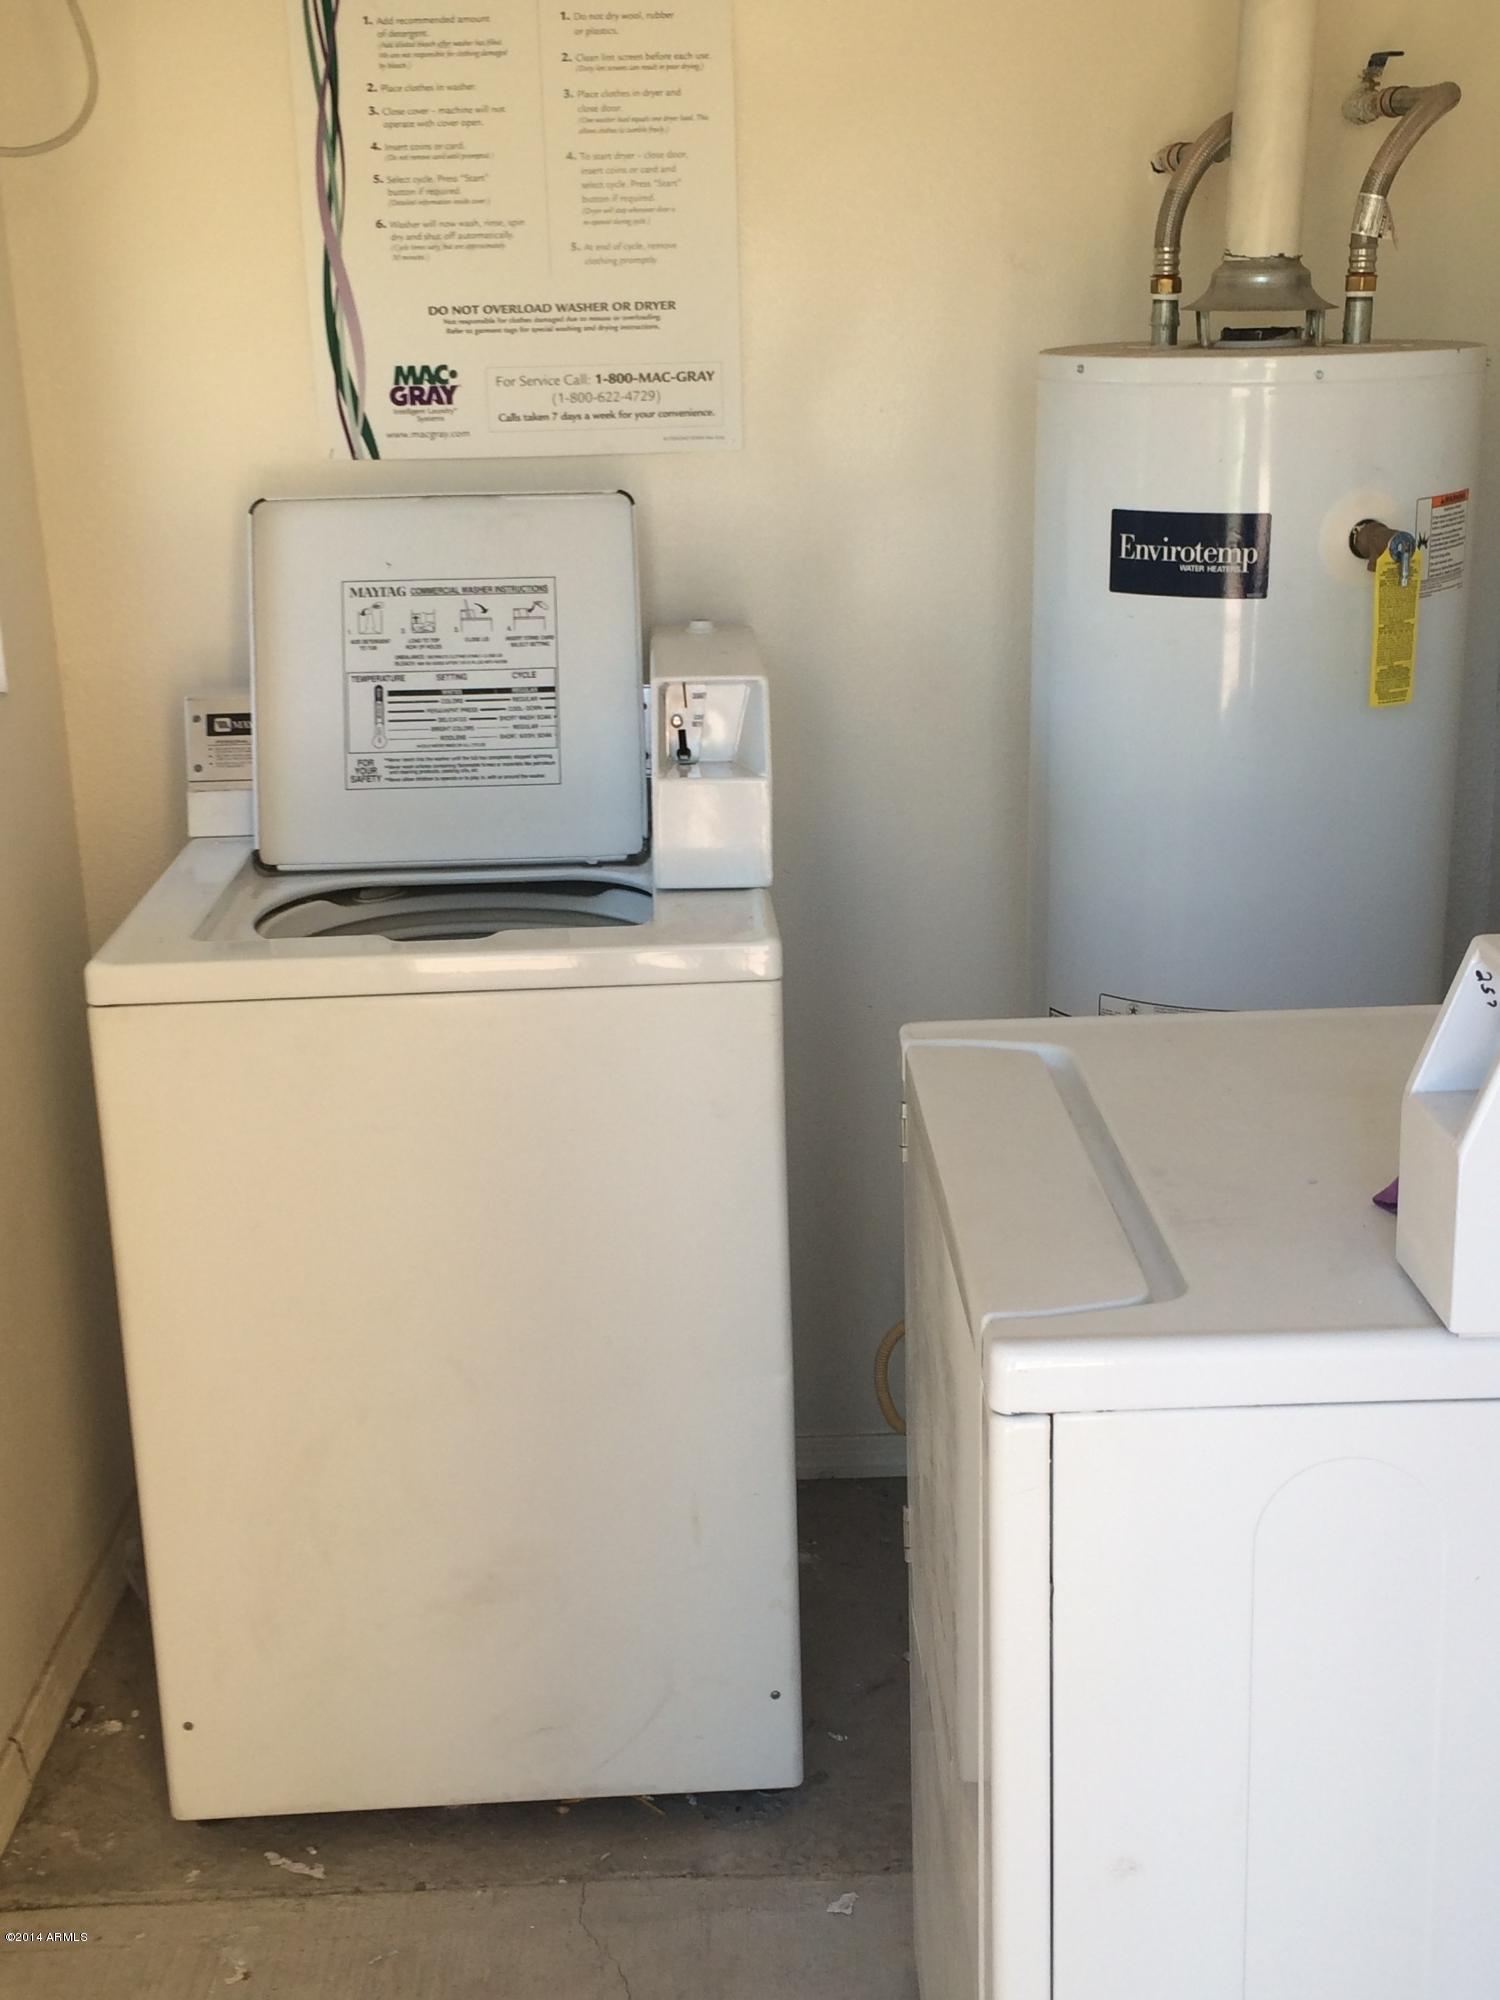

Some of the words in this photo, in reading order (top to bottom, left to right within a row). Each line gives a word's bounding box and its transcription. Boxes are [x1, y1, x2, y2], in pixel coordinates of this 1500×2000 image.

[362, 15, 373, 25] 1.
[376, 16, 393, 25] Add
[396, 15, 455, 24] recommended
[457, 16, 490, 24] amount
[560, 11, 570, 21] 1.
[574, 12, 587, 21] Do
[605, 12, 619, 22] dry
[621, 11, 644, 20] wool,
[646, 11, 674, 19] rubber
[574, 28, 583, 36] or
[585, 27, 618, 37] plastics.
[561, 52, 572, 62] 2.
[575, 53, 599, 62] Clean
[601, 52, 615, 61] lint
[645, 52, 672, 60] before
[674, 52, 693, 60] each
[366, 83, 377, 92] 2.
[404, 83, 434, 91] clothes
[436, 83, 444, 91] in
[563, 89, 574, 98] 3.
[577, 90, 599, 98] Place
[601, 89, 630, 97] clothes
[632, 89, 640, 97] in
[643, 89, 663, 98] dryer
[666, 88, 682, 96] and
[368, 106, 379, 116] 3.
[382, 107, 405, 116] Close
[438, 106, 473, 114] machine
[475, 105, 489, 113] will
[578, 104, 599, 113] close
[383, 121, 415, 129] operate
[417, 119, 435, 127] with
[370, 142, 381, 150] 4.
[566, 152, 576, 160] 4.
[579, 152, 591, 160] To
[593, 152, 612, 160] start
[614, 151, 635, 161] dryer
[581, 167, 603, 175] insert
[640, 165, 658, 173] card
[660, 165, 677, 173] and
[373, 174, 384, 183] 5.
[437, 174, 458, 182] Press
[581, 181, 603, 189] select
[630, 180, 650, 188] Press
[375, 219, 387, 229] 6.
[390, 220, 420, 228] Washer
[422, 219, 436, 228] will
[406, 232, 422, 240] and
[424, 232, 441, 240] shut
[444, 230, 456, 240] off
[570, 242, 581, 251] 5.
[595, 242, 611, 251] end
[613, 241, 622, 250] of
[585, 257, 618, 266] clothing
[428, 305, 448, 316] DO
[452, 305, 479, 315] NOT
[483, 304, 552, 314] OVERLOAD
[555, 302, 609, 312] WASHER
[612, 301, 631, 311] OR
[634, 300, 676, 311] DRYER
[458, 317, 495, 325] responsible
[534, 316, 564, 324] damaged
[474, 328, 501, 336] garment
[555, 326, 582, 334] washing
[598, 324, 618, 332] drying
[495, 376, 516, 387] For
[519, 375, 560, 387] Service
[563, 373, 591, 385] Call:
[596, 370, 715, 384] 1-800-MAC-GRAY
[389, 385, 459, 406] GRAY
[552, 390, 661, 407] (1-800-622-4729)
[498, 413, 521, 422] Calls
[523, 411, 550, 421] taken
[551, 412, 558, 421] 7
[561, 411, 582, 423] days
[592, 410, 616, 419] week
[618, 409, 632, 419] for
[635, 411, 656, 421] your
[658, 408, 715, 418] convenience.
[385, 431, 471, 441] www.macgray.com
[1119, 533, 1258, 573] Envirotemp
[1179, 564, 1205, 572] WATER
[350, 586, 407, 598] MAYTAG
[410, 587, 460, 596] COMMERCIAL
[462, 586, 492, 594] WASHER
[495, 584, 548, 594] INSTRUCTIONS
[351, 674, 405, 683] TEMPERATURE
[436, 673, 468, 681] SETTING
[511, 671, 536, 679] CYCLE
[357, 759, 374, 767] FOR
[350, 775, 381, 783] SAFETY
